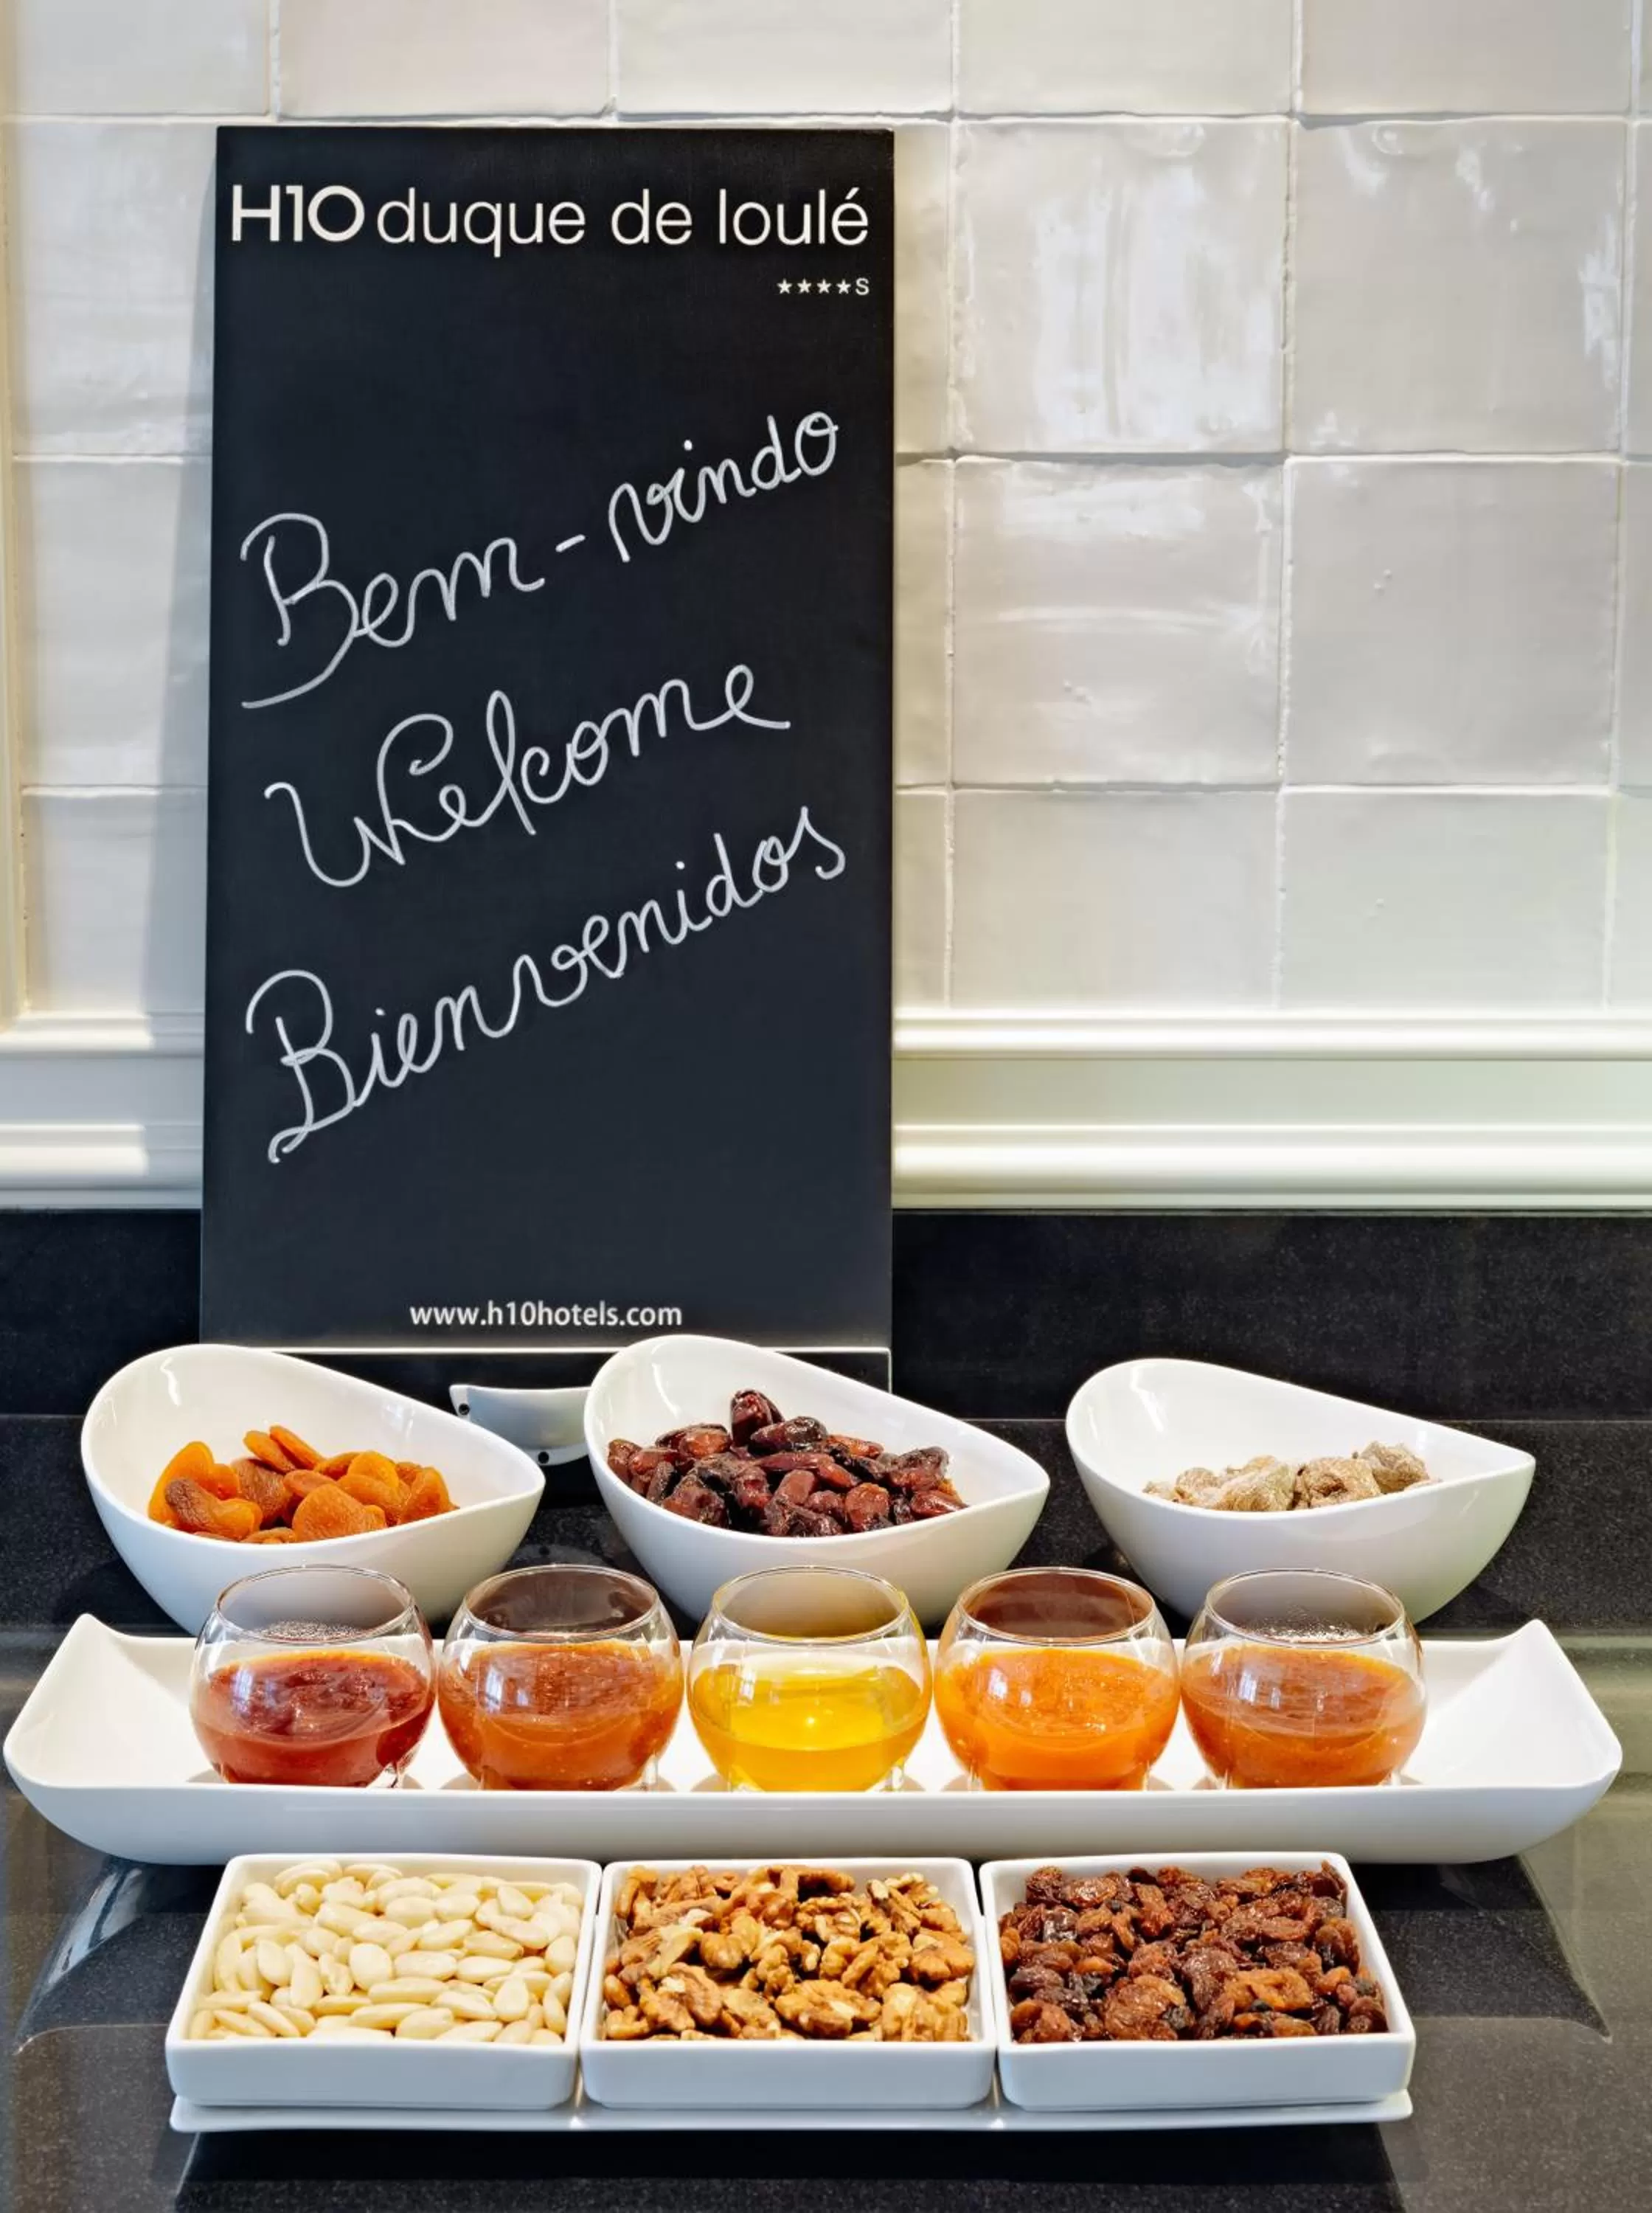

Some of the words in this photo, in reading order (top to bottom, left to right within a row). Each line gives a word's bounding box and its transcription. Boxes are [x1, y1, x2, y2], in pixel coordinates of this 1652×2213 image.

[231, 184, 366, 243] H10
[376, 186, 586, 259] duque
[611, 187, 693, 246] de
[718, 186, 869, 246] loulé
[263, 664, 792, 888] Welcome
[245, 806, 847, 1164] Bienvenidos
[409, 1299, 683, 1327] www.h10hotels.com
